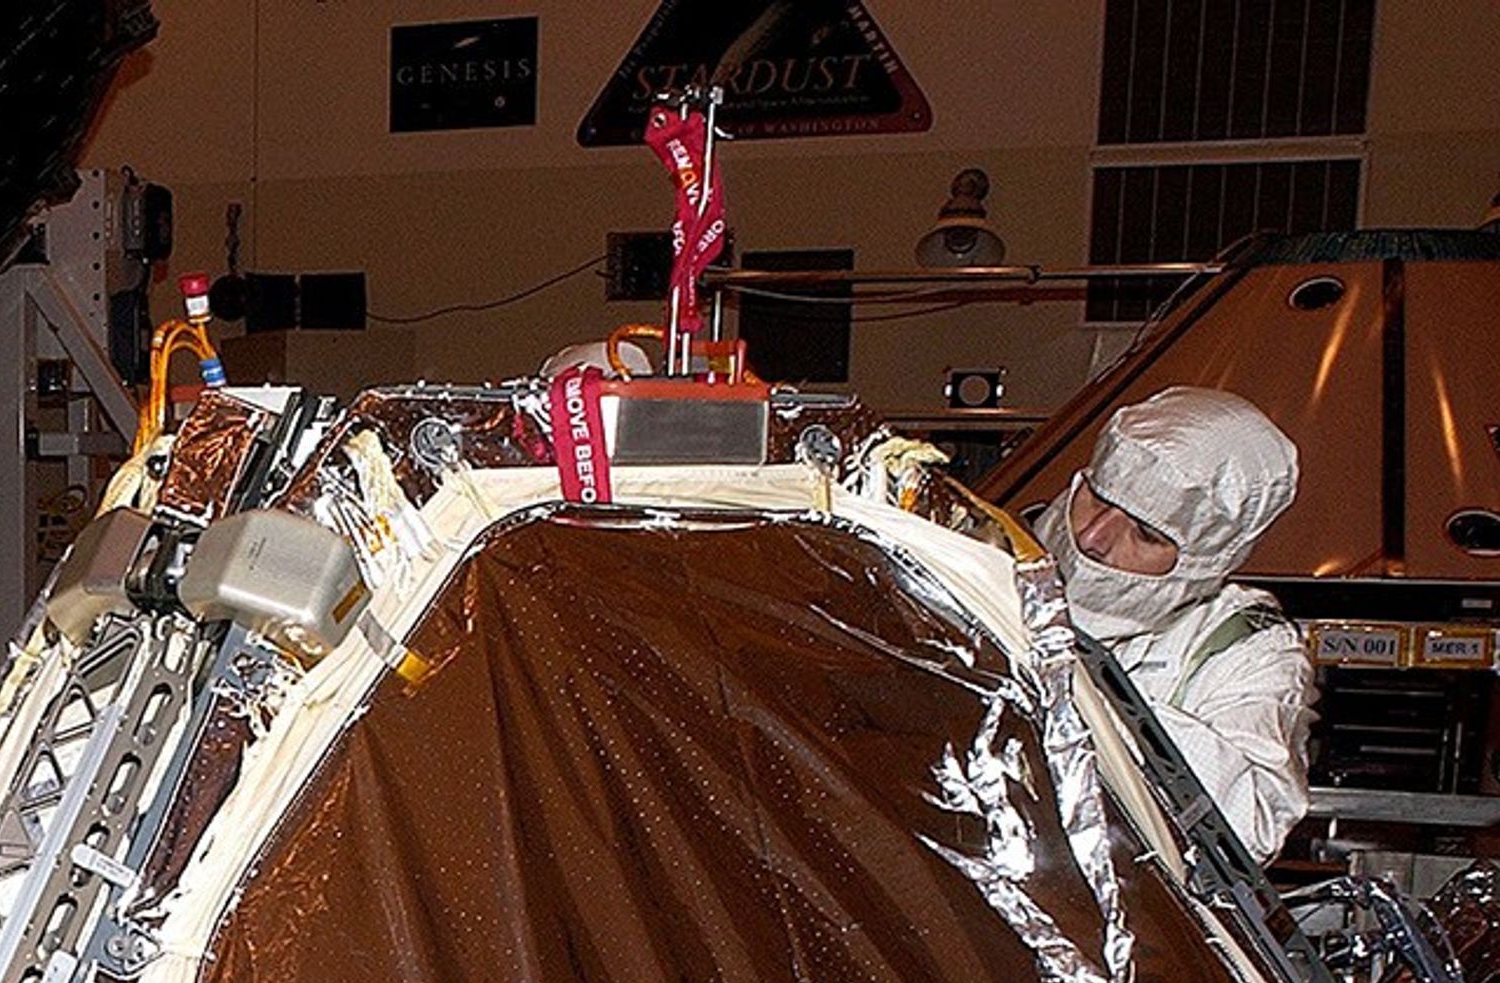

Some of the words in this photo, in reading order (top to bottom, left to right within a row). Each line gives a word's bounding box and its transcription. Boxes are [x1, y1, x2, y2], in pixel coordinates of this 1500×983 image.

[847, 2, 898, 74] MARTIN
[395, 57, 533, 86] GENESIS
[632, 54, 873, 101] STARDUST
[574, 444, 597, 503] BEFO
[1364, 638, 1396, 656] 001
